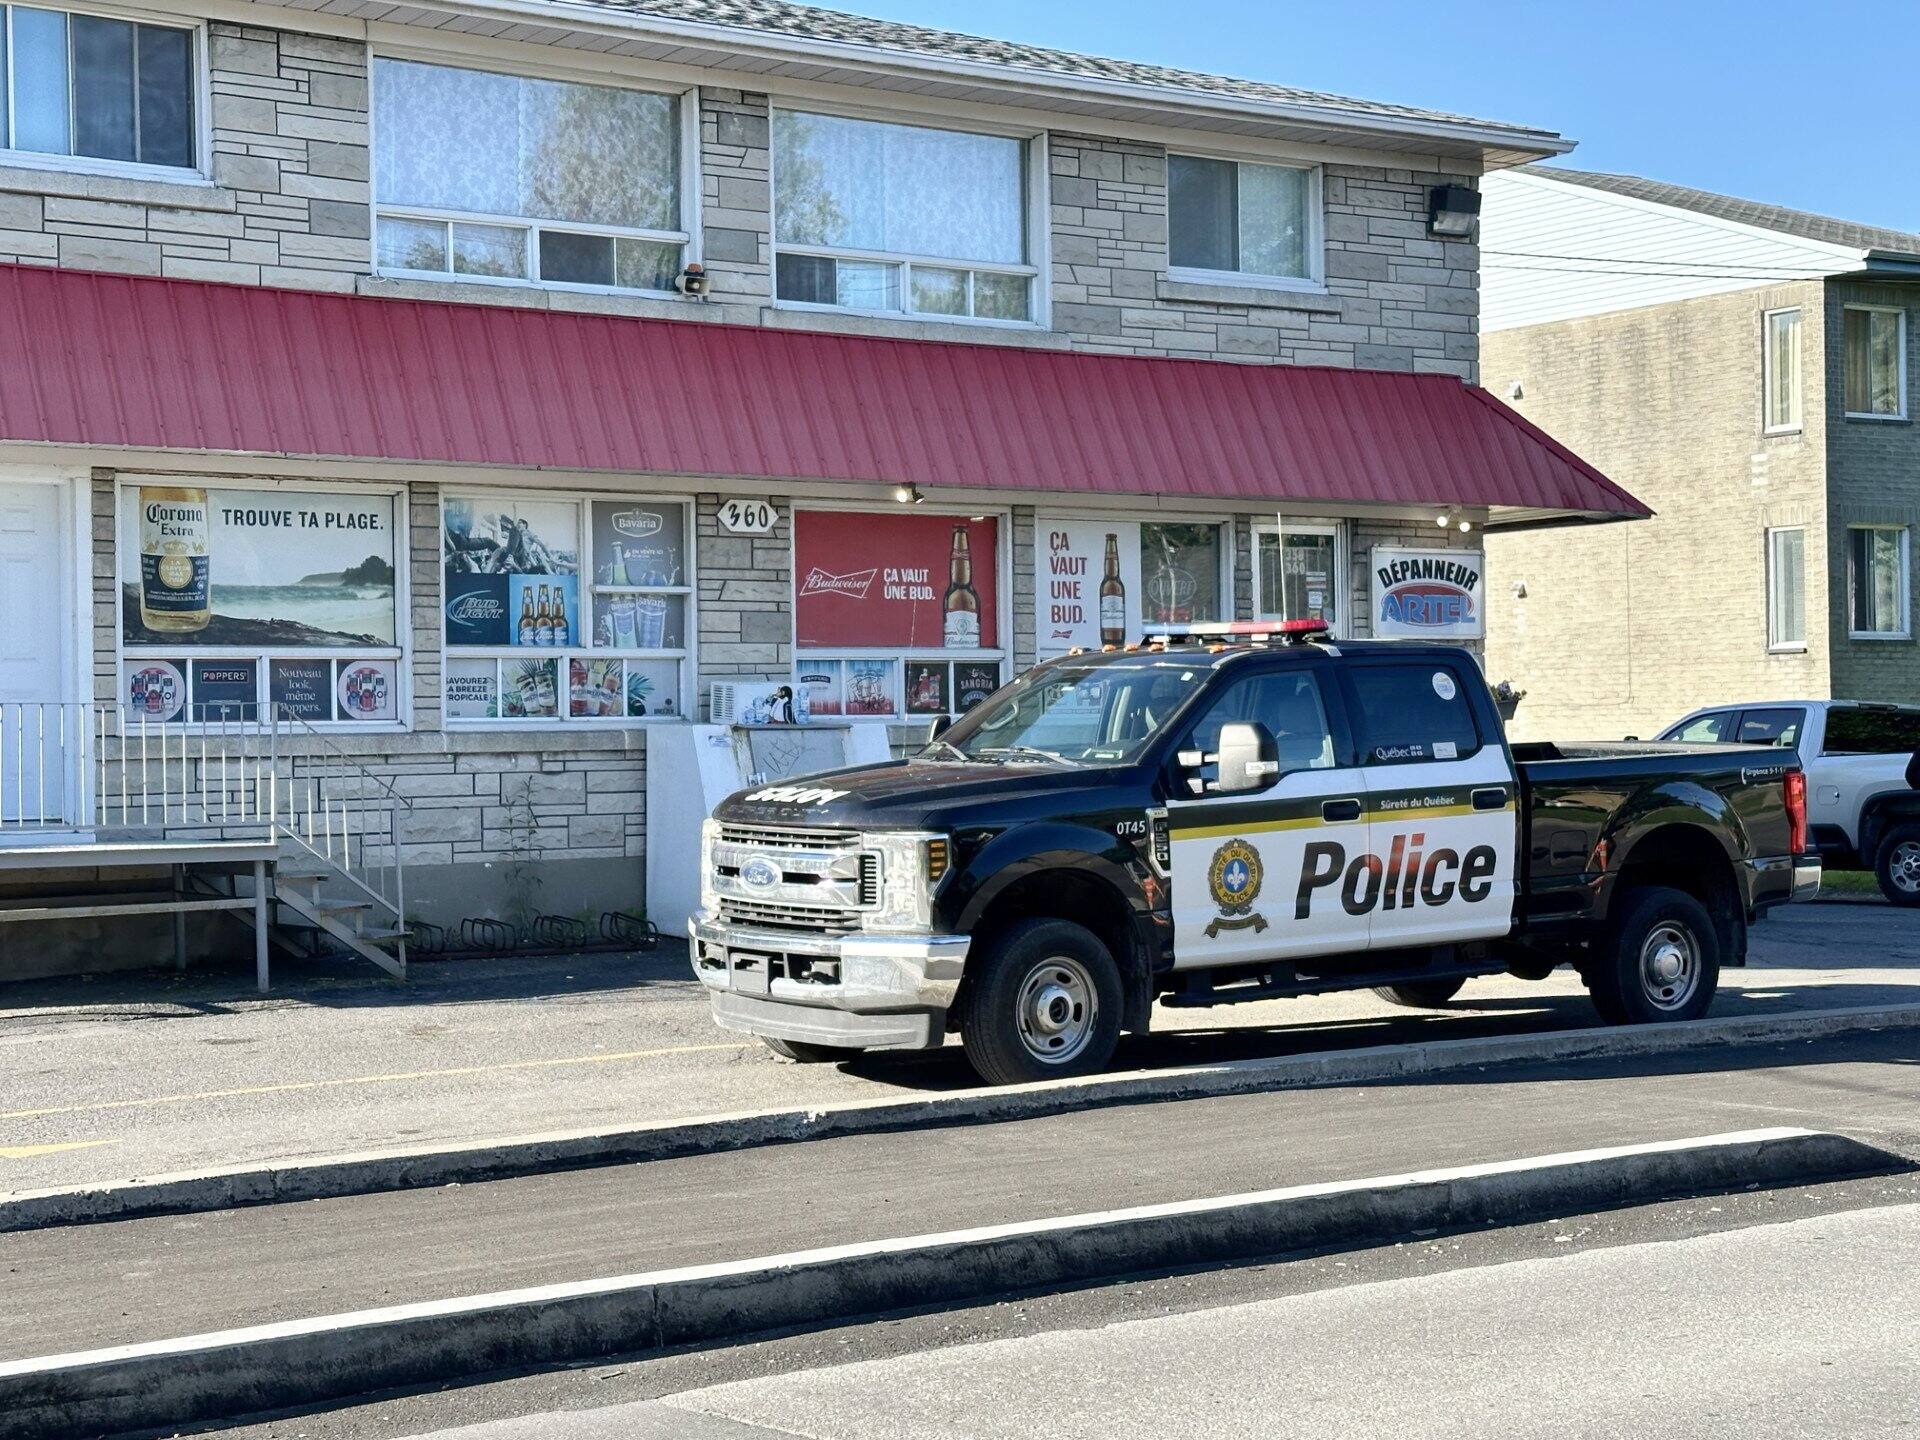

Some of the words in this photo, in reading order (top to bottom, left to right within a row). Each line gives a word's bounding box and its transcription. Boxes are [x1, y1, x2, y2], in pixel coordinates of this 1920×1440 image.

[146, 503, 203, 525] Corona
[222, 509, 292, 527] TROUVE
[299, 512, 319, 528] TA
[325, 512, 384, 530] PLAGE.
[728, 503, 768, 527] 360
[161, 524, 194, 536] Extra
[619, 518, 657, 528] Bavaria
[1050, 531, 1069, 555] ÇA
[1050, 557, 1087, 576] VAUT
[1377, 559, 1479, 591] DÉPANNEUR
[806, 574, 869, 589] Budweiser
[884, 568, 898, 585] ÇA
[901, 569, 929, 583] VAUT
[884, 586, 907, 600] UNE
[910, 586, 936, 600] BUD.
[1051, 581, 1082, 599] UNE
[1051, 605, 1087, 623] BUD.
[1381, 593, 1475, 623] ARTEL
[279, 668, 321, 678] Nouveau
[960, 679, 993, 690] SANGRIA
[286, 691, 316, 700] même
[1376, 747, 1410, 760] Québec
[1380, 798, 1408, 810] Sûreté
[1410, 798, 1421, 807] du
[1424, 795, 1455, 807] Québec
[1294, 832, 1497, 920] Police
